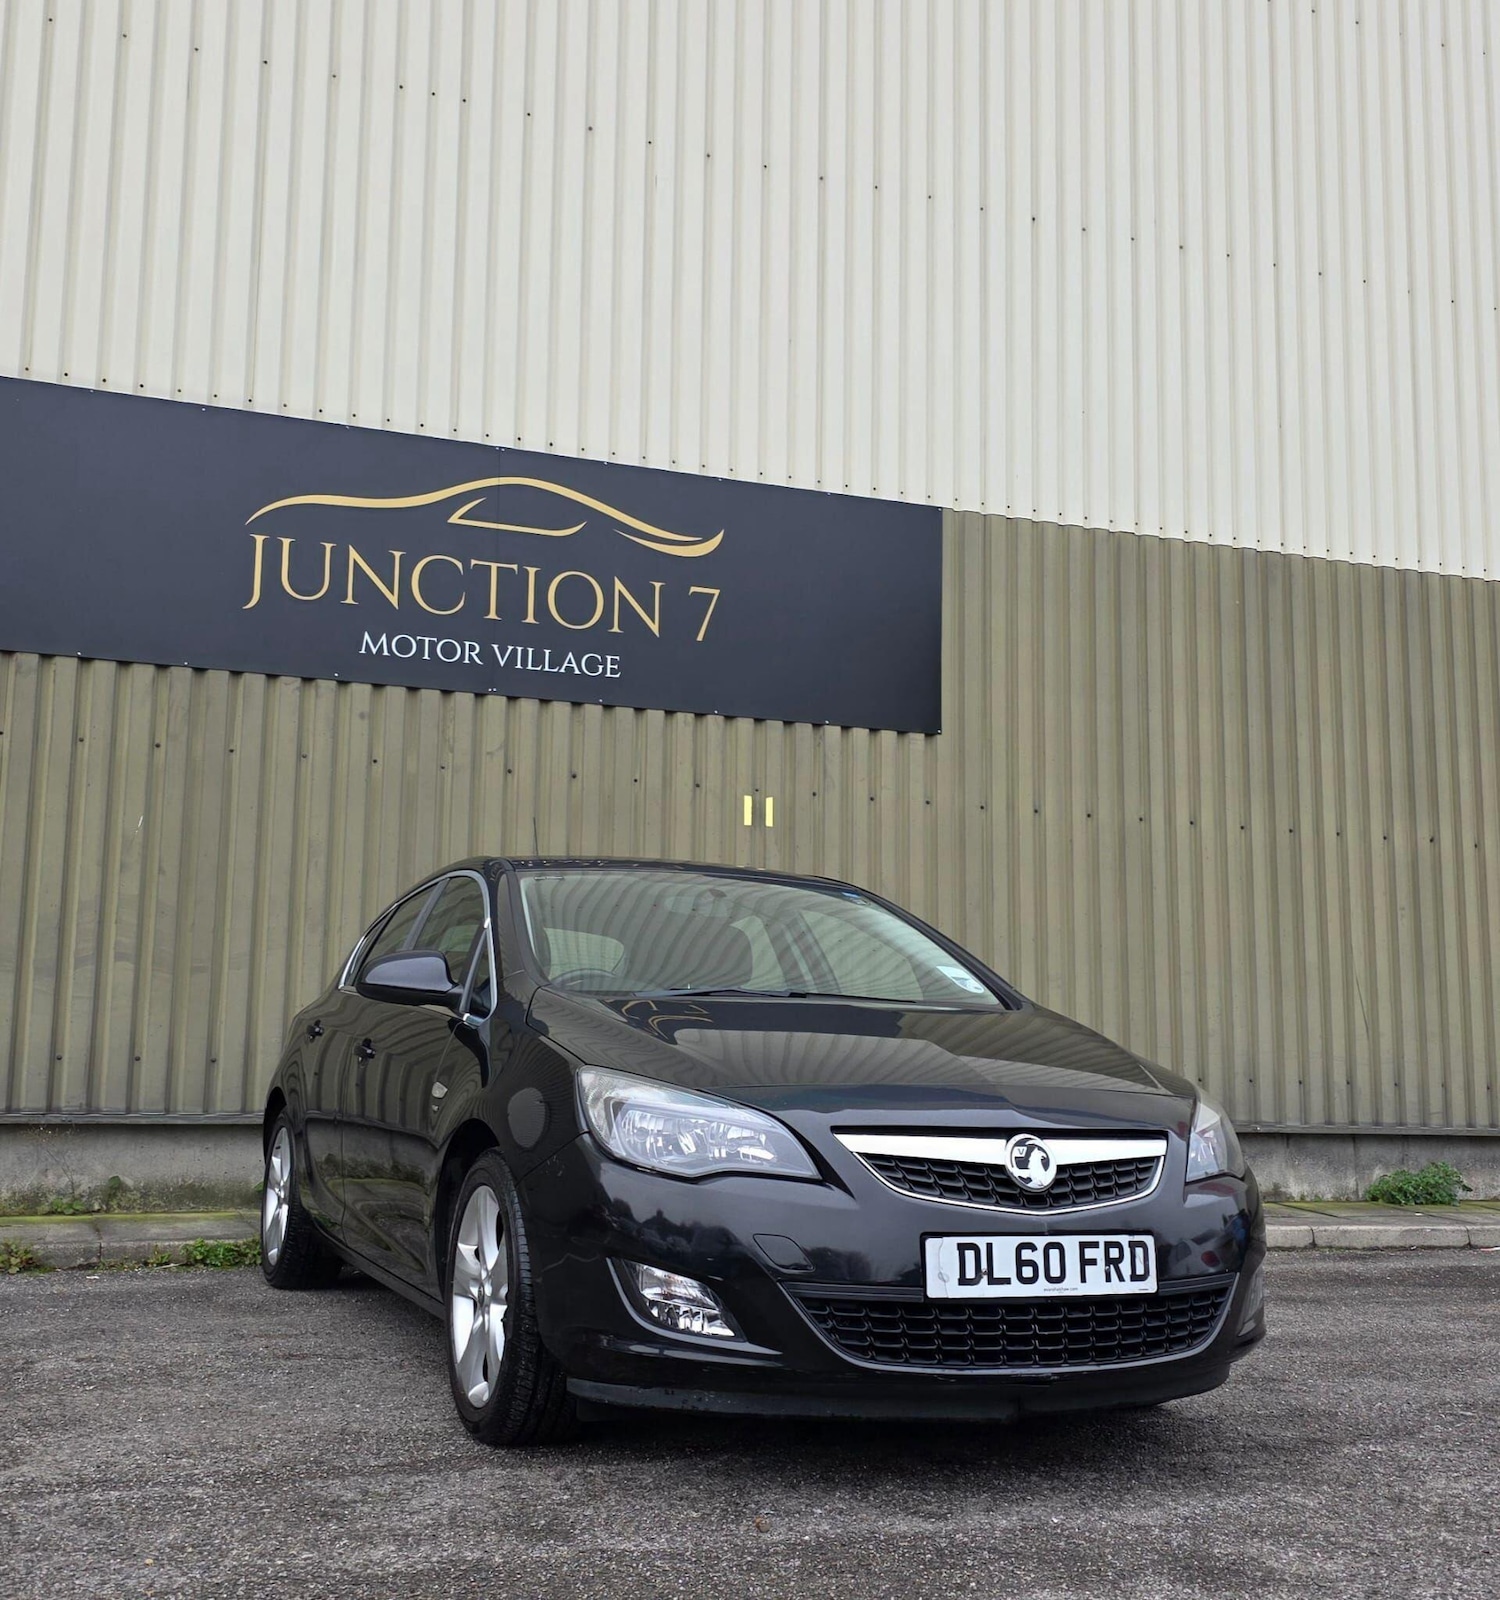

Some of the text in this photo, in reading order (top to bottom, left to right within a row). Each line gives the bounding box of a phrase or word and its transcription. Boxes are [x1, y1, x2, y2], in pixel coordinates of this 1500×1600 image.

[242, 533, 721, 642] JUNCTION 7
[358, 630, 622, 679] MOTOR VILLAGE
[957, 1240, 1150, 1286] DL60 FRD
